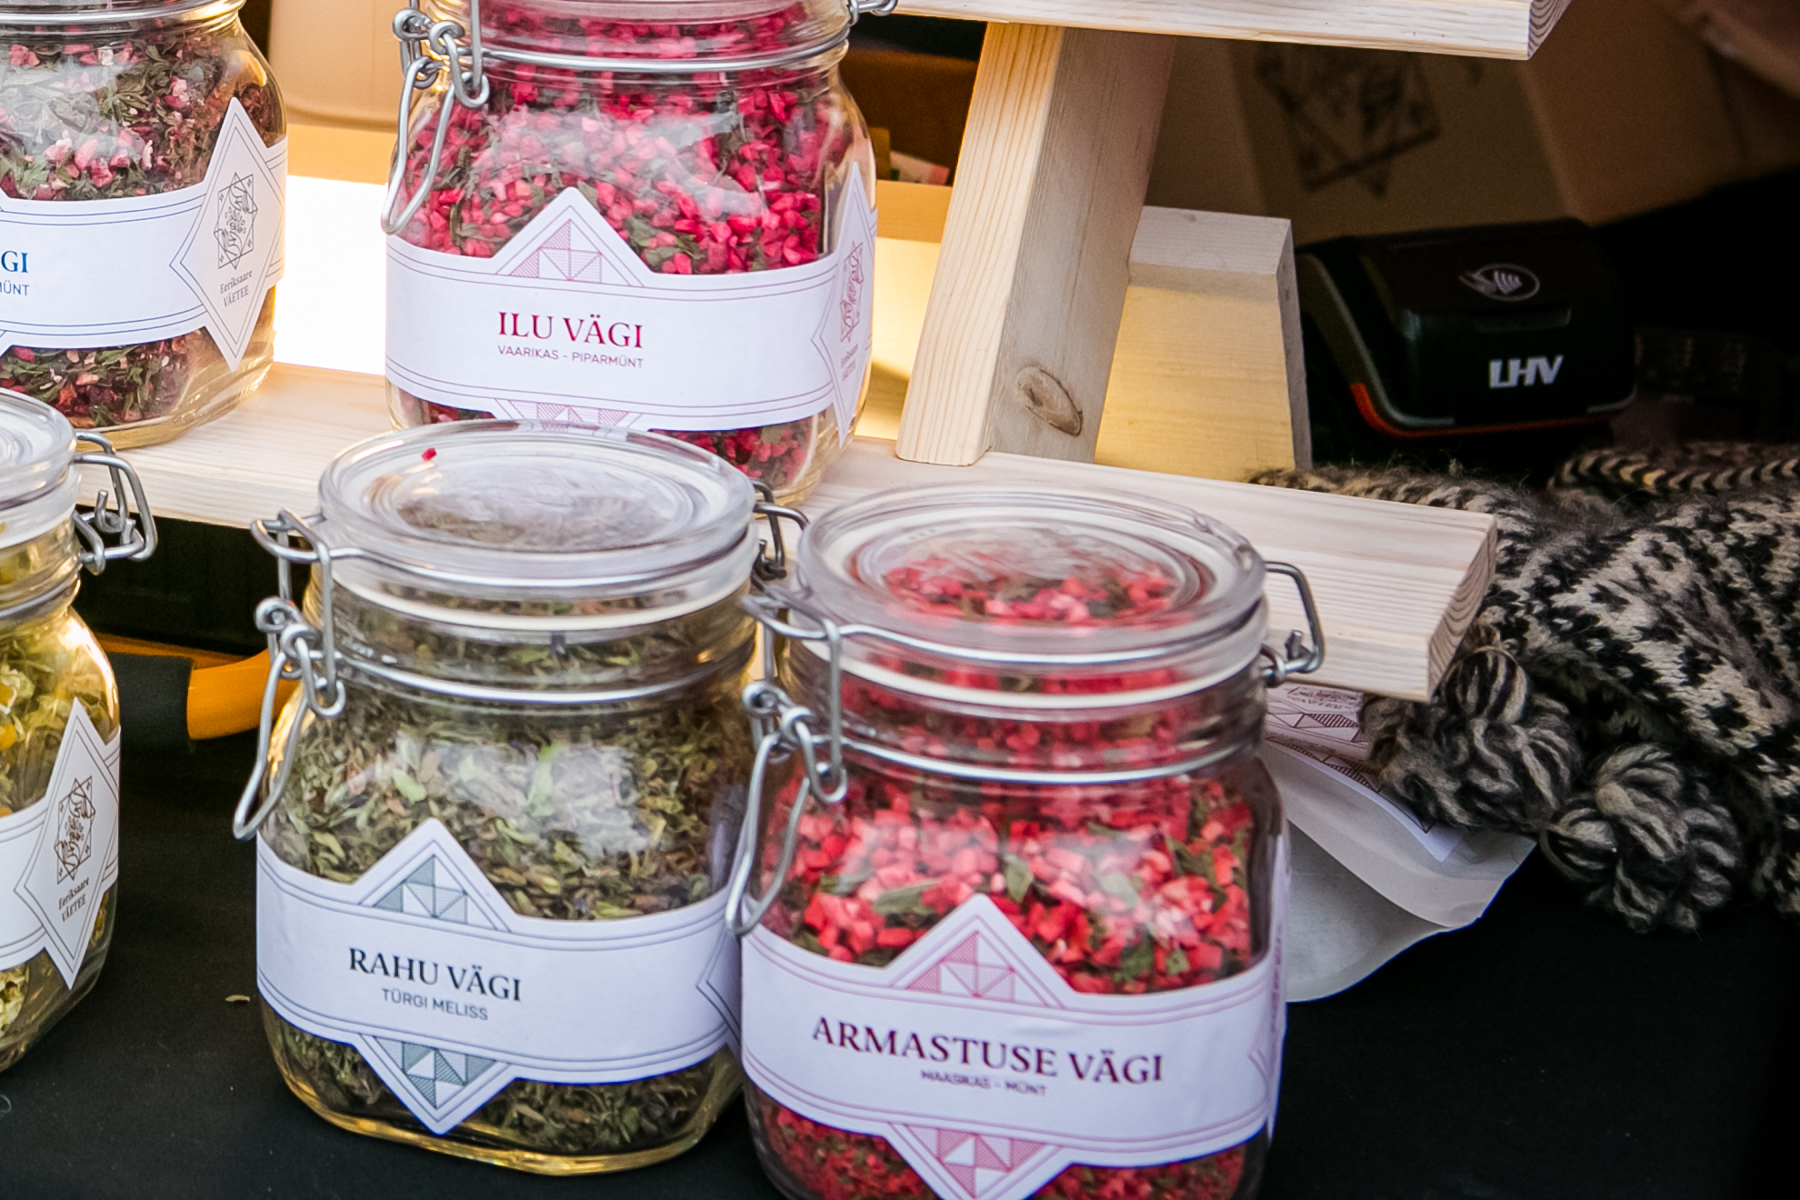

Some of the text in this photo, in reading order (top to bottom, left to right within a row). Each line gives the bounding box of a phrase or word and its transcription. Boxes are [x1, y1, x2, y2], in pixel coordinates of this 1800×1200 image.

[220, 269, 253, 295] Eeriksaare
[224, 285, 249, 307] VÄETEE
[498, 311, 643, 349] ILU VÄGI
[497, 345, 559, 362] VAARIKAS
[571, 351, 644, 369] PIPARMÜNT
[1489, 354, 1563, 389] LHV
[59, 877, 90, 910] Eeriksaare
[62, 892, 86, 922] VÄETEE
[349, 947, 521, 1003] RAHU VÄGI
[382, 987, 489, 1021] TÜRGI MELISS
[813, 1016, 1164, 1085] ARMASTUSE VÄGI
